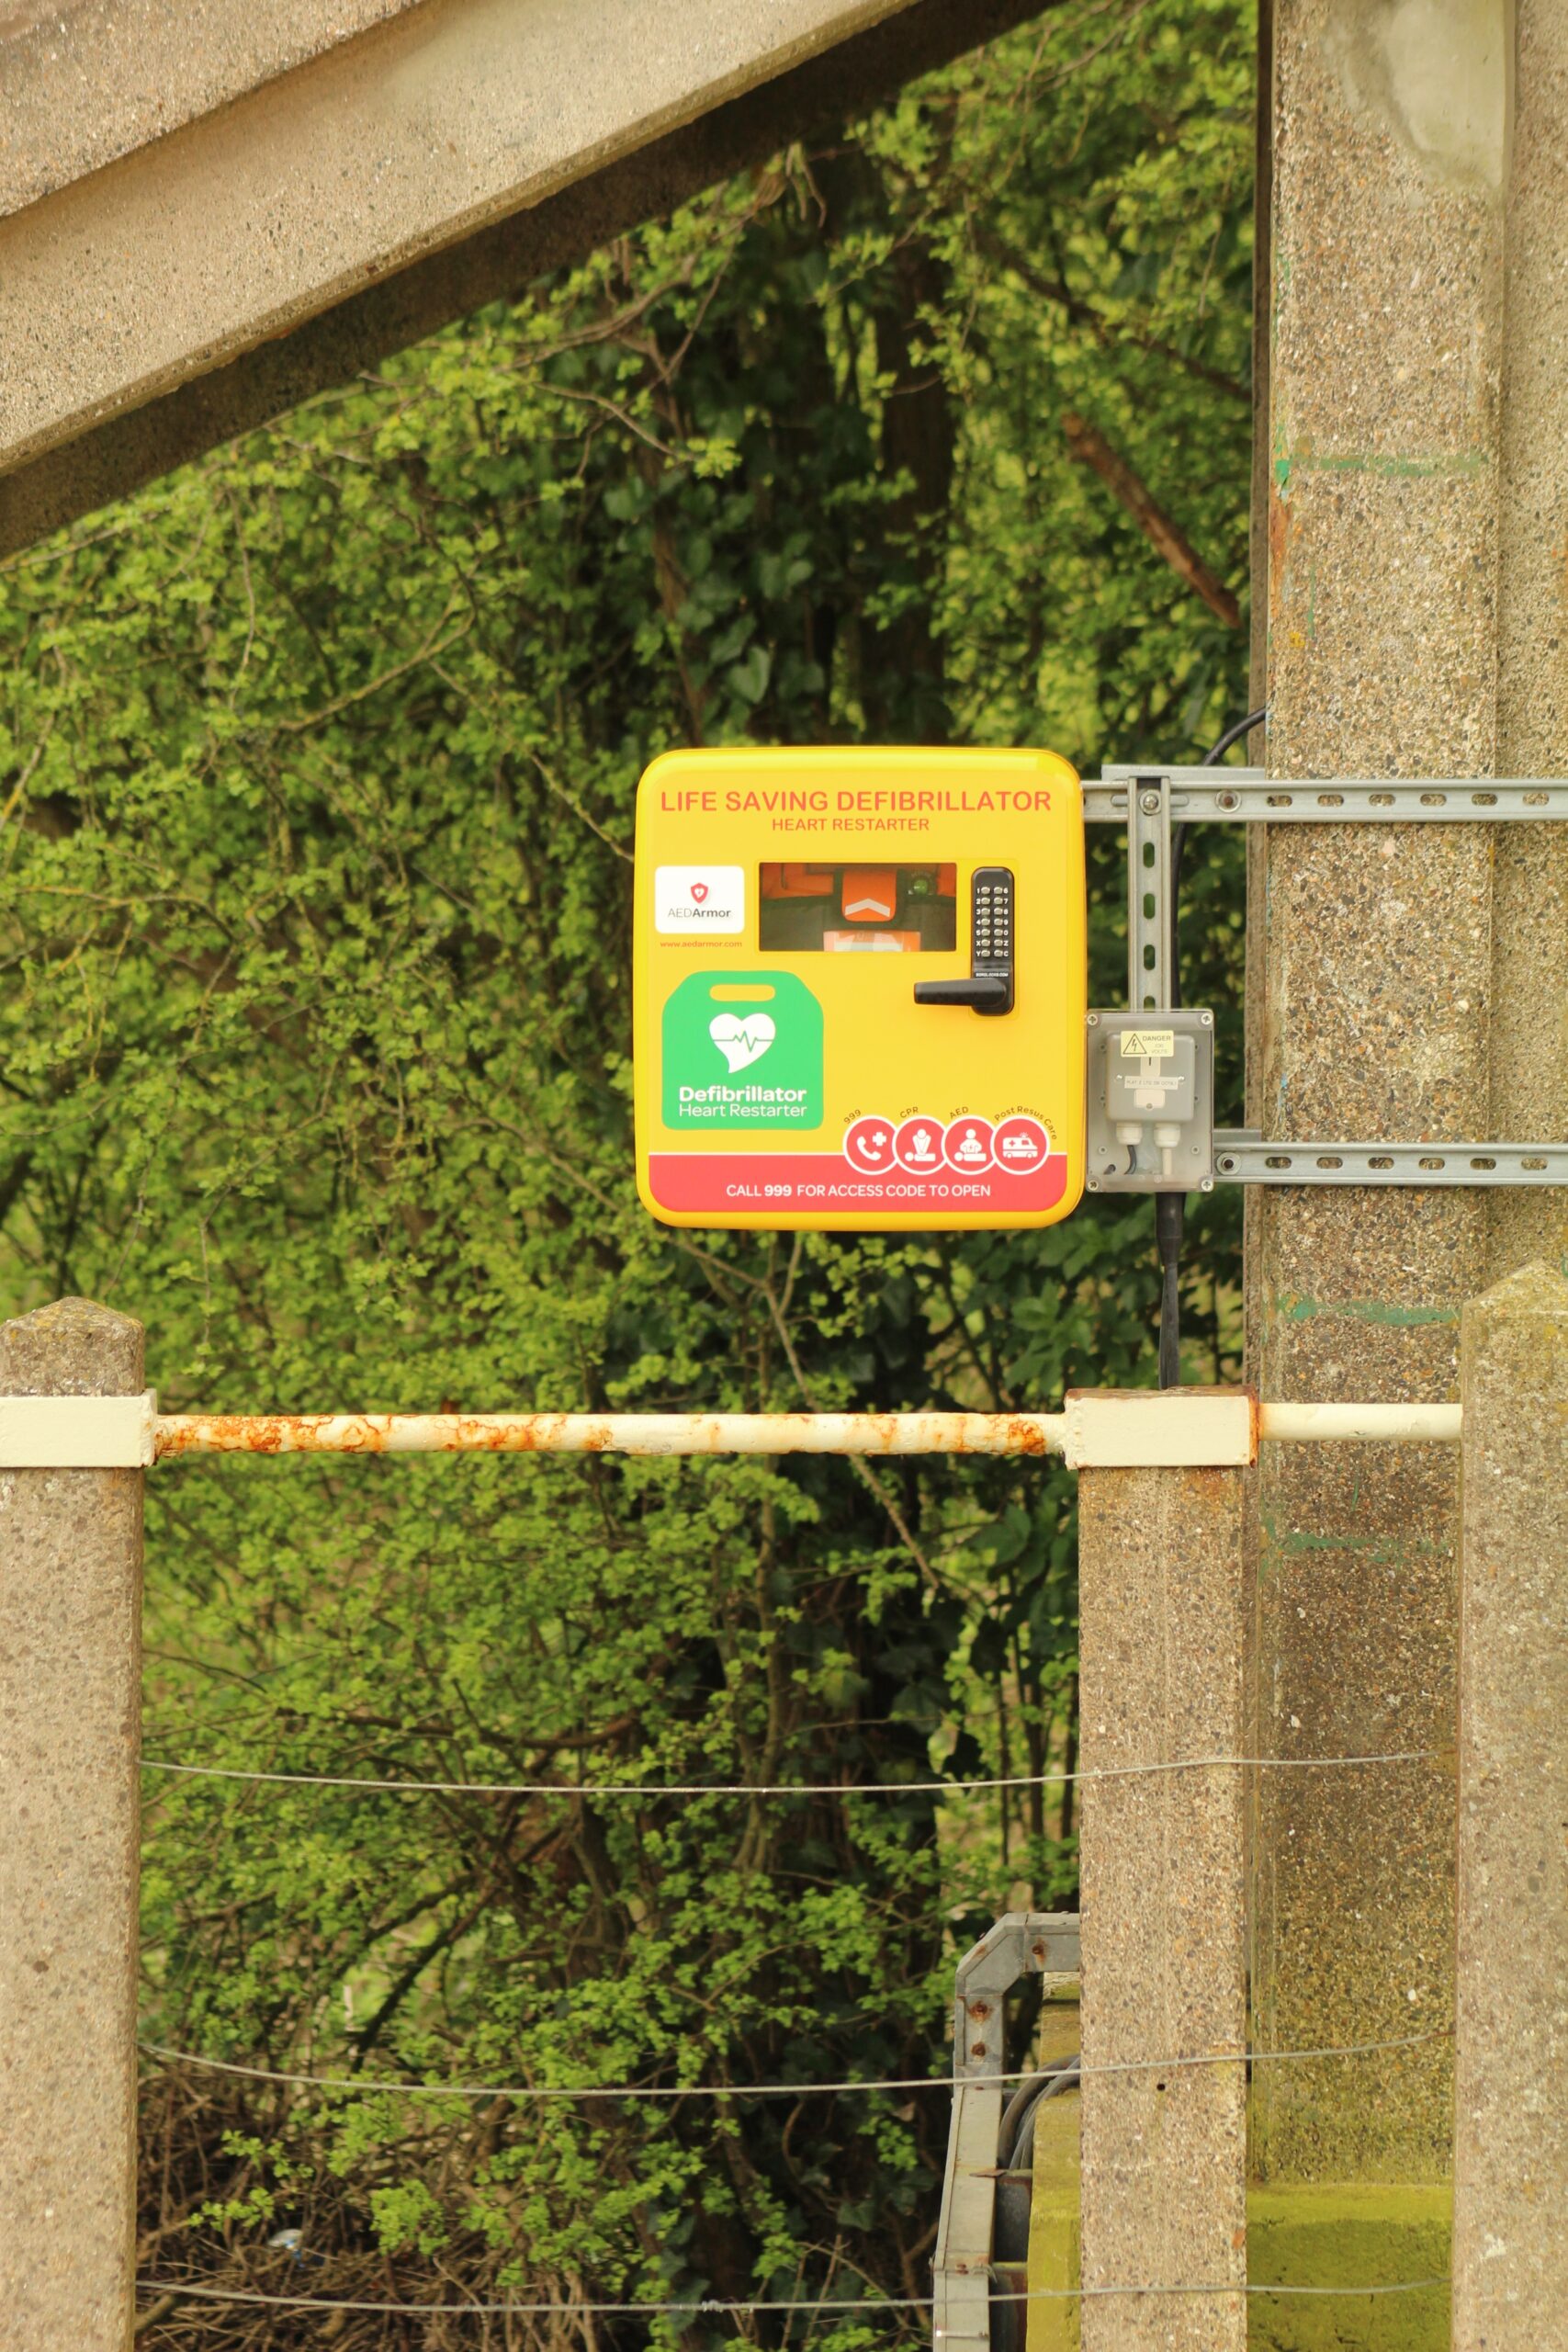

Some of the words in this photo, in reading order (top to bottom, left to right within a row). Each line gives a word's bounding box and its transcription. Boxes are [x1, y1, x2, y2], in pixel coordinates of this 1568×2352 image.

[661, 791, 717, 811] LIFE
[726, 790, 829, 811] SAVING
[837, 790, 1051, 811] DEFIBRILLATOR
[772, 818, 828, 831] HEART
[832, 818, 930, 831] RESTARTER
[668, 908, 731, 918] AEDArmor
[660, 940, 743, 948] www.aedarmor.com
[679, 1085, 807, 1102] Defibrillator
[679, 1103, 727, 1117] Heart
[729, 1103, 807, 1117] Restarter
[899, 1106, 919, 1118] CPR
[949, 1106, 969, 1119] AED
[843, 1109, 862, 1125] 999
[994, 1107, 1015, 1121] Post
[1017, 1105, 1044, 1120] Resus
[1043, 1118, 1057, 1140] Care
[726, 1184, 761, 1197] CALL
[764, 1184, 792, 1197] 999
[797, 1184, 826, 1197] FOR
[828, 1184, 884, 1197] ACCESS
[886, 1184, 927, 1197] CODE
[929, 1184, 950, 1197] TO
[952, 1184, 991, 1197] OPEN
